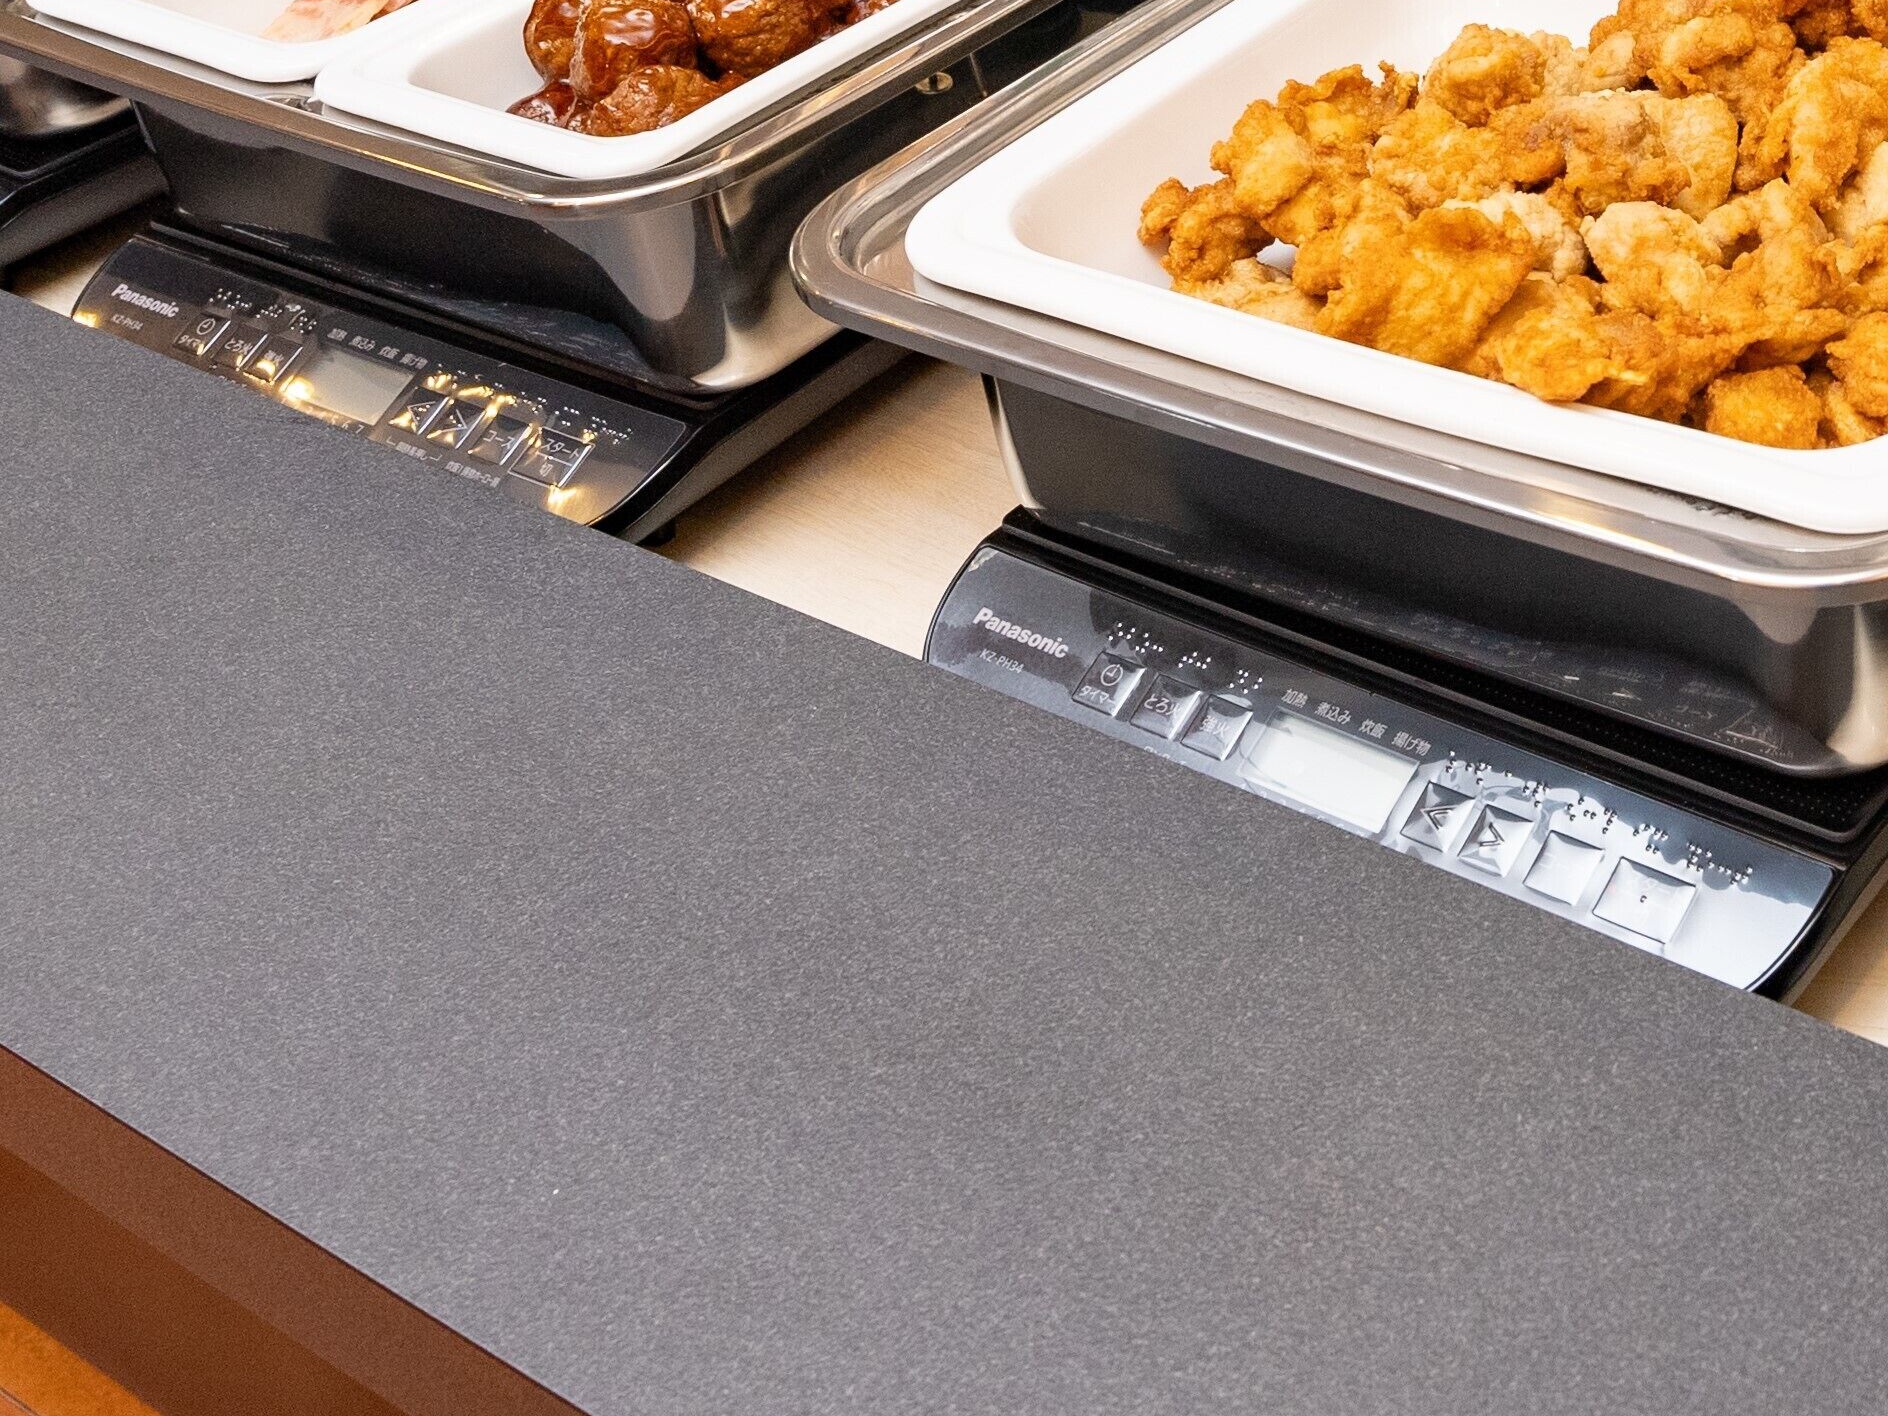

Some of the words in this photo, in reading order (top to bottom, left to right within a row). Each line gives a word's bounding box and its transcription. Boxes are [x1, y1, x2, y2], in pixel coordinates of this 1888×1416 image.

[111, 283, 180, 318] Panasonic
[540, 437, 580, 460] スタート
[972, 606, 1069, 659] Panasonic
[1079, 684, 1117, 705] タイマー
[1281, 688, 1309, 709] 加熱
[1314, 701, 1352, 726] 煮込み
[1359, 718, 1388, 740] 炊飯
[1391, 730, 1432, 757] 揚げ物
